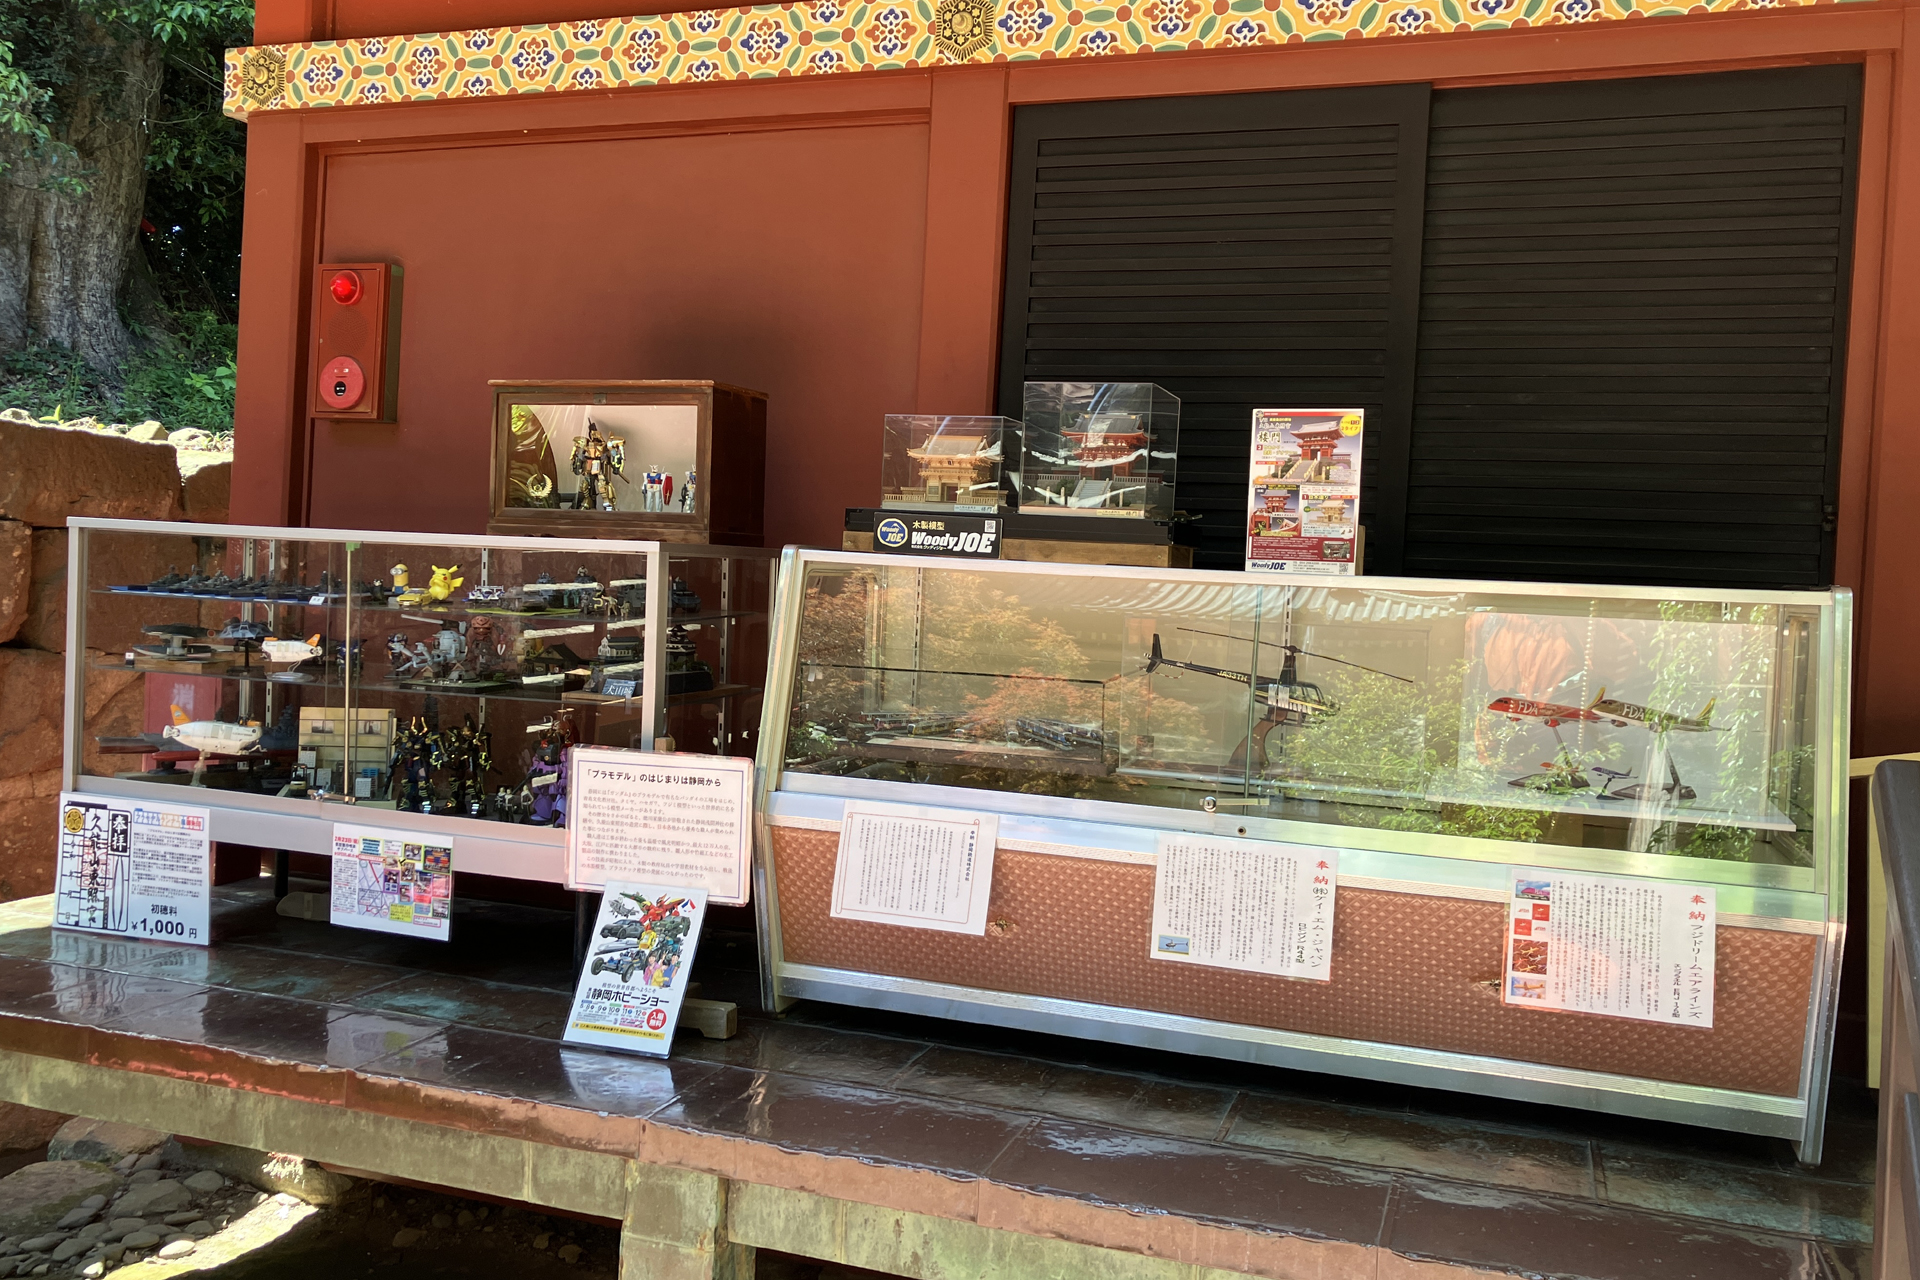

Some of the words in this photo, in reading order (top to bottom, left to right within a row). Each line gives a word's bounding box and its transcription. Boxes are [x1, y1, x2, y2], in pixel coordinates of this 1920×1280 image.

[1257, 431, 1281, 443] 楼門
[912, 520, 945, 530] 木製模型
[886, 532, 904, 542] JOE
[1518, 700, 1539, 716] FDA
[1622, 704, 1645, 720] FDA
[112, 815, 128, 852] 奉拝
[86, 813, 104, 924] 久能山東照宮
[150, 904, 178, 917] 初穂料
[188, 928, 198, 939] 円
[592, 988, 670, 1006] 静岡ホビーショー
